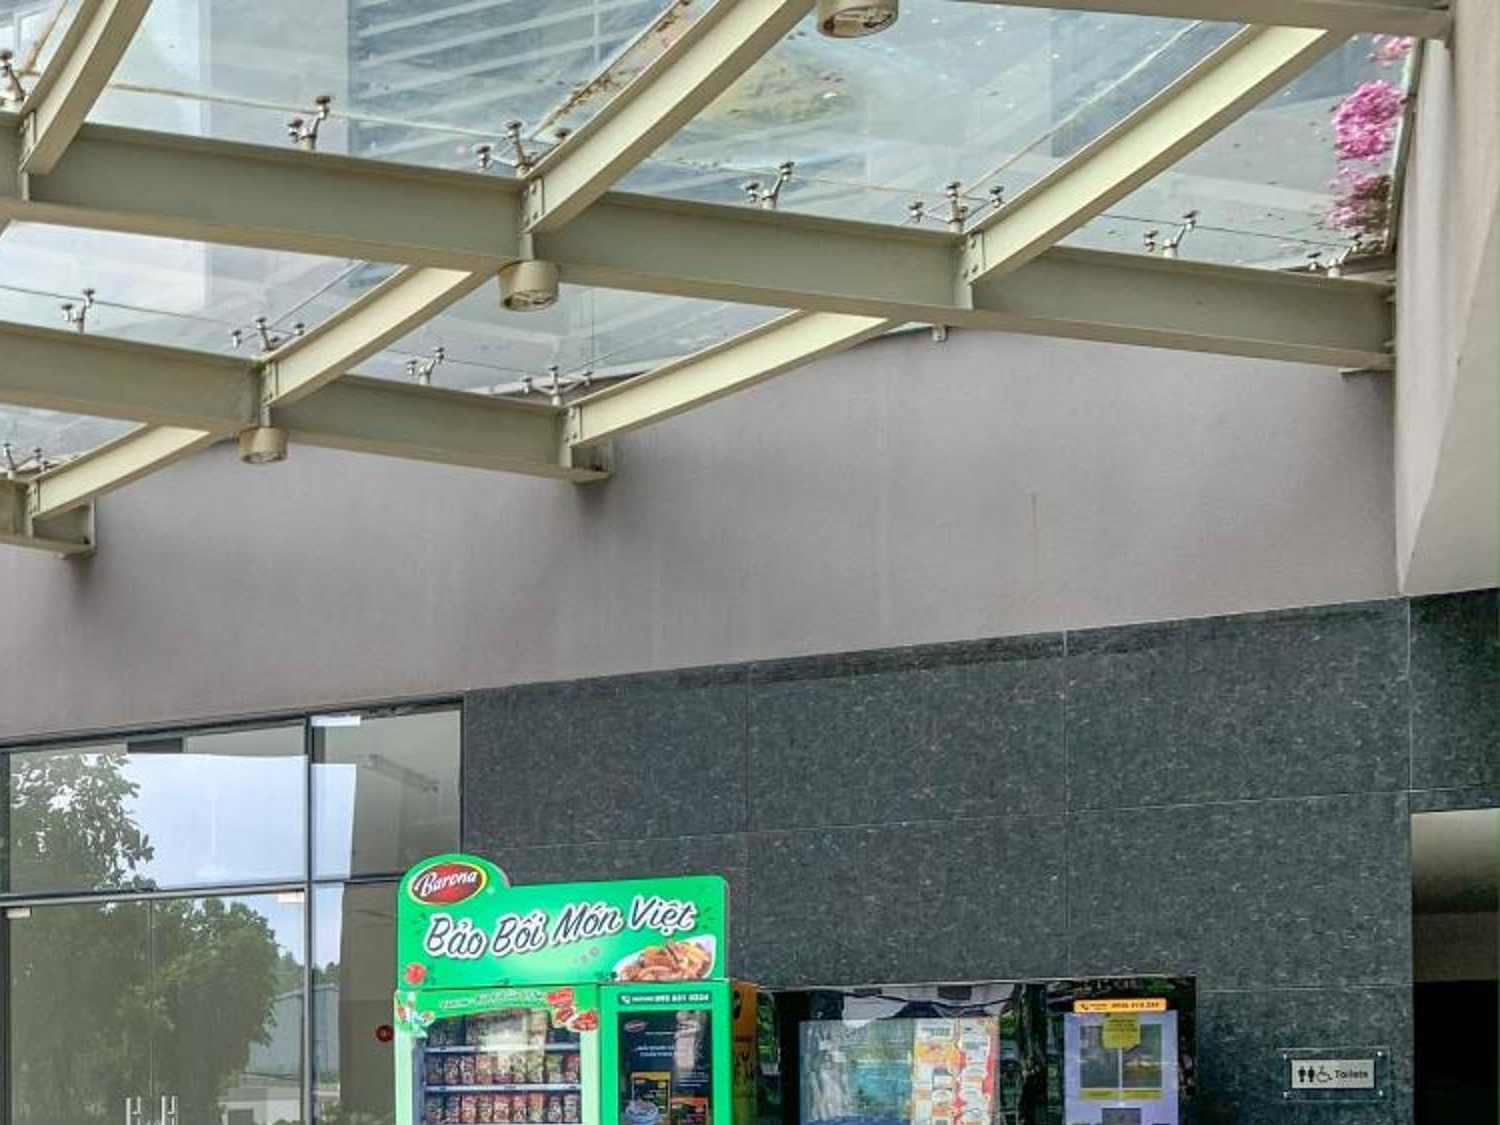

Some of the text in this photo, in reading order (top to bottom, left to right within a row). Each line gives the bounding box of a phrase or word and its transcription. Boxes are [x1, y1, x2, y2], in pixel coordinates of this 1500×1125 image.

[413, 871, 478, 897] Barona
[426, 895, 695, 957] Bảo Bối Món Việt
